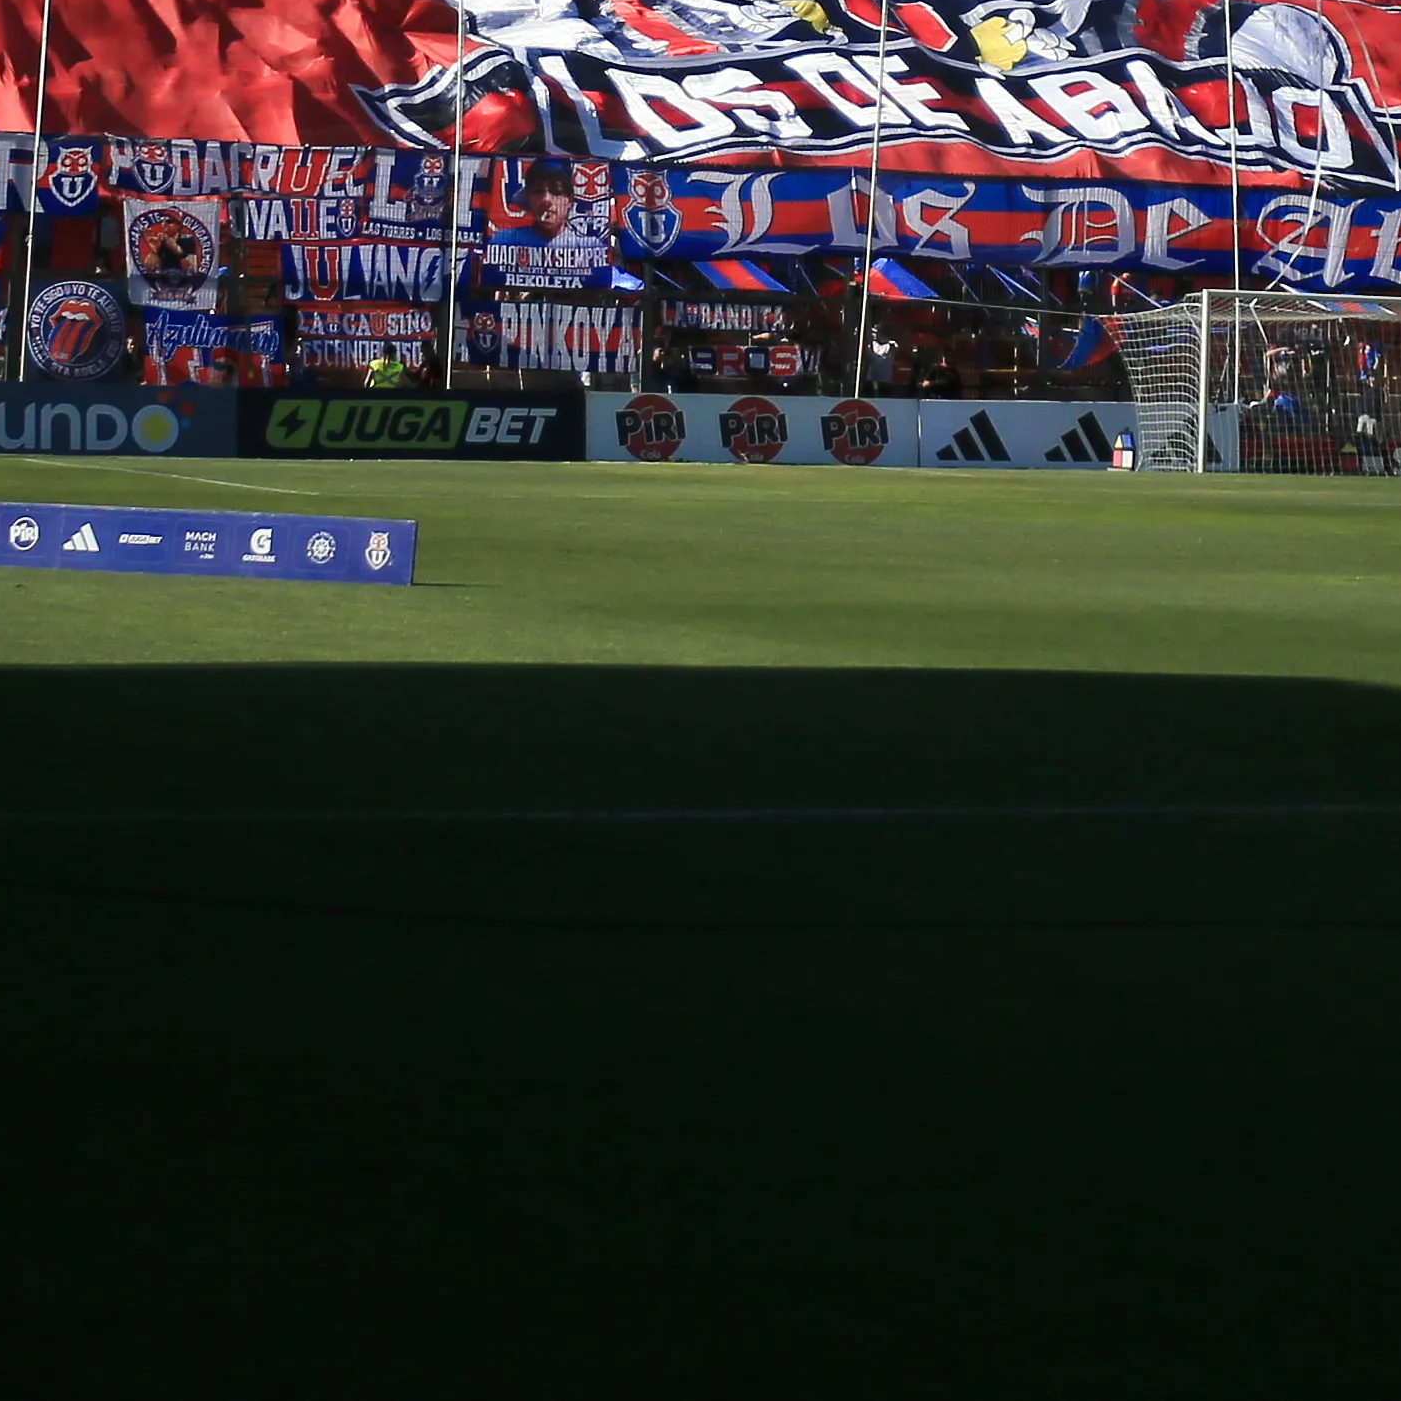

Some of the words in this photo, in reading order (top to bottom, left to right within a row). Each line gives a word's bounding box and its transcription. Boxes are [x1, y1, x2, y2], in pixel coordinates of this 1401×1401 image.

[540, 54, 813, 161] LOS
[786, 49, 970, 131] DE
[976, 62, 1354, 169] ABAJO
[362, 220, 382, 237] LAS
[384, 223, 417, 241] TORRES
[483, 244, 543, 267] JOAQUIN
[543, 246, 553, 268] X
[555, 246, 610, 269] SIEMPRE
[505, 274, 583, 289] REKOLETA
[72, 283, 86, 296] YO
[86, 286, 98, 299] TE
[499, 303, 641, 374] PINKOYA
[184, 530, 217, 542] MACH
[184, 542, 215, 552] BANK
